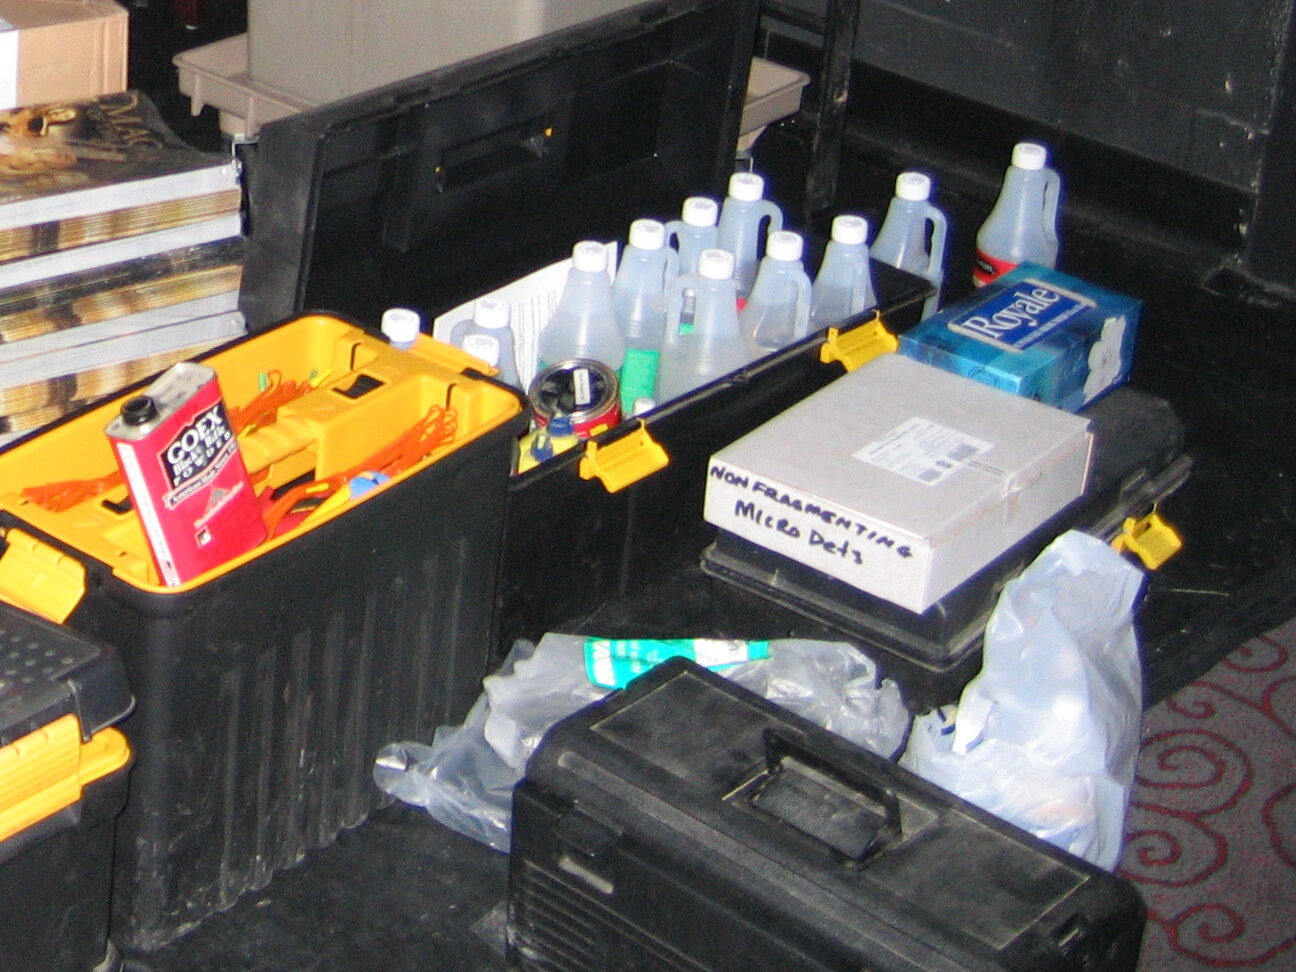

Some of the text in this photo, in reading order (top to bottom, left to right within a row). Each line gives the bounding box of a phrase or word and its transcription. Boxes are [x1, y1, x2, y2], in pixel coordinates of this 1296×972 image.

[961, 288, 1061, 340] Royale
[167, 405, 223, 465] GOEX
[710, 465, 915, 559] NON FRAGMENTING
